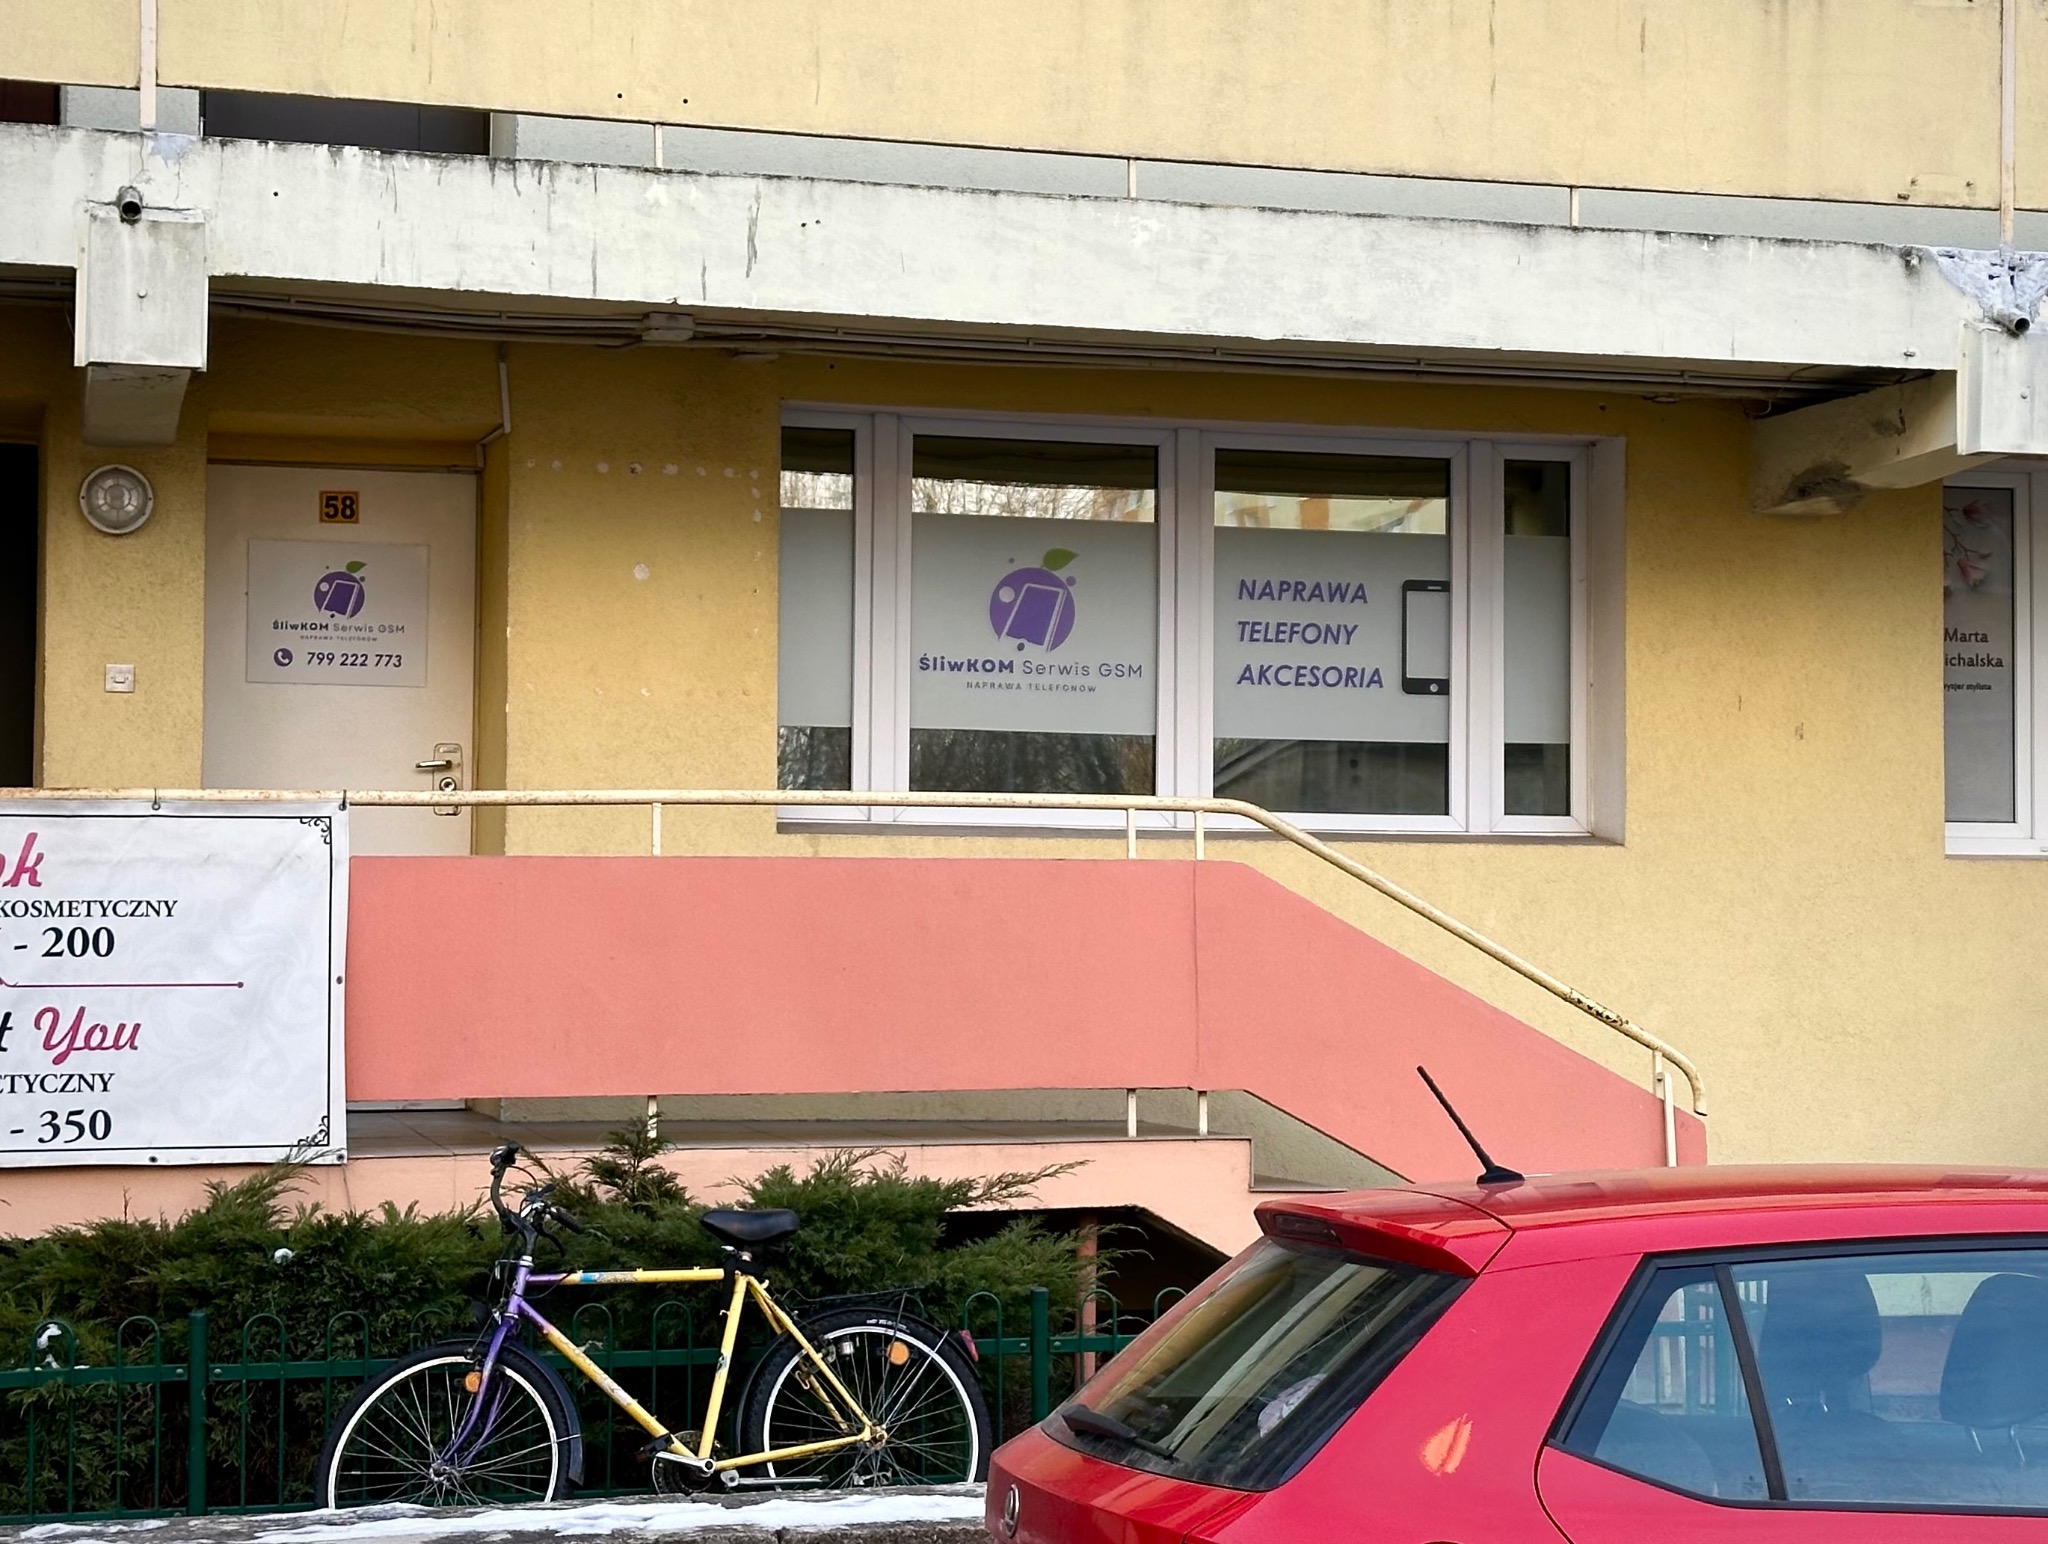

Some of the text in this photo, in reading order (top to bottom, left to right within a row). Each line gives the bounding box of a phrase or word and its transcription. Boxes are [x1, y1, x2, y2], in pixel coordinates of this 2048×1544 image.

[324, 495, 356, 520] 58
[1238, 578, 1368, 604] NAPRAWA
[272, 619, 405, 634] ŚliwKOM Serwis GSM
[1237, 620, 1359, 645] TELEFONY
[1944, 627, 1989, 643] Marta
[307, 652, 402, 668] 799 222 773
[918, 653, 1143, 679] ŚliwKOM Serwis GSM
[966, 681, 1022, 691] NAPRAWA
[1237, 663, 1384, 689] AKCESORIA
[0, 900, 179, 918] KOSMETYCZNY
[41, 926, 115, 958] 200
[33, 1005, 142, 1066] You
[37, 1109, 112, 1144] 350
